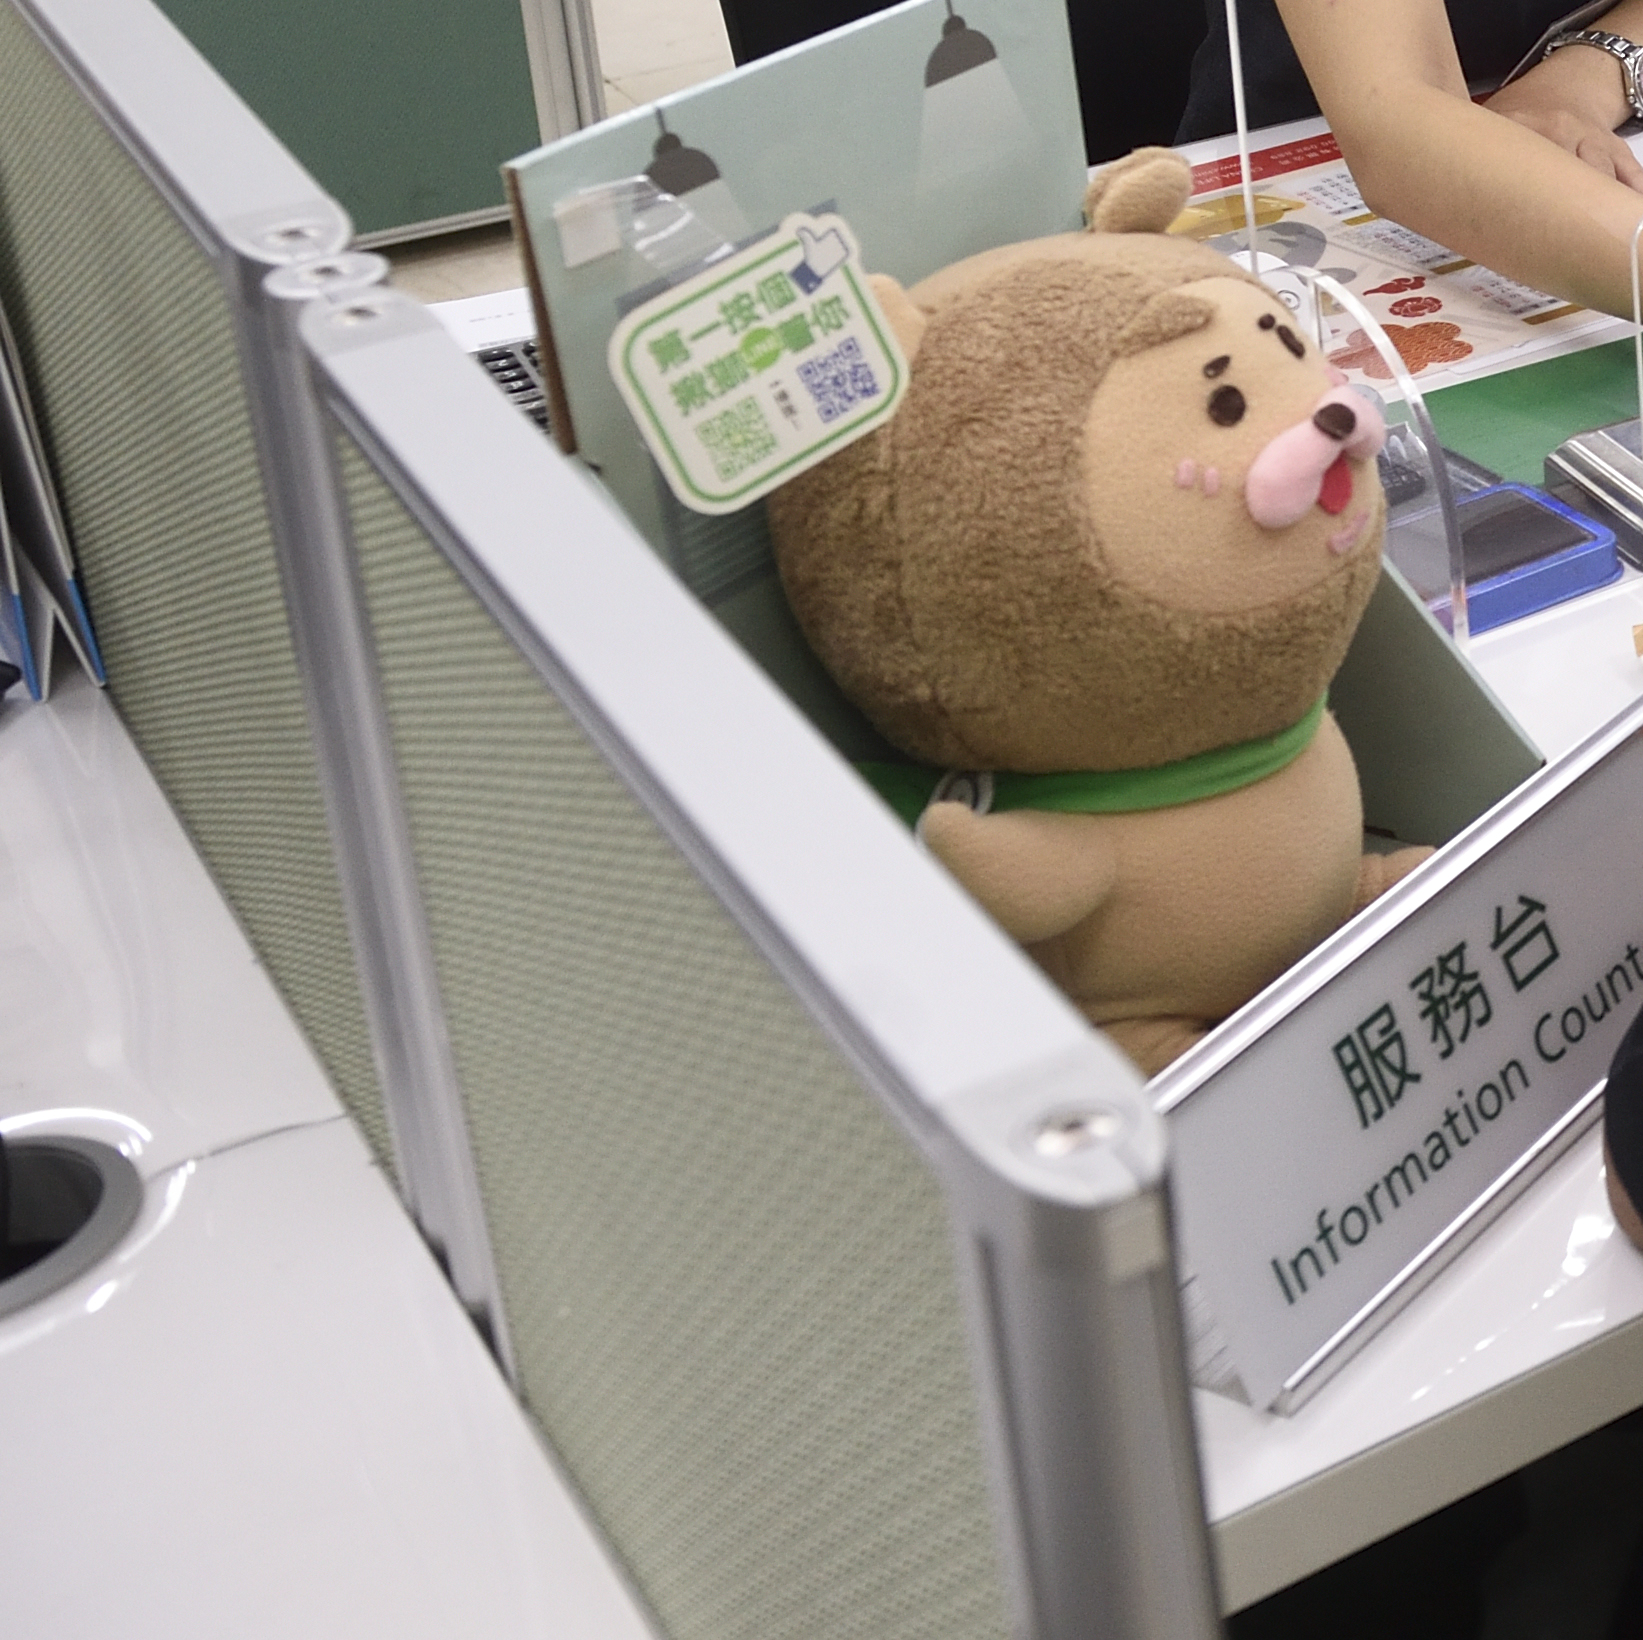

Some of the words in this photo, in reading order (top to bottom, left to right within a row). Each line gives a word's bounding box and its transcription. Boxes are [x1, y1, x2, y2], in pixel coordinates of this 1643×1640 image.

[1332, 894, 1562, 1130] 服務台
[1271, 1058, 1531, 1305] Information
